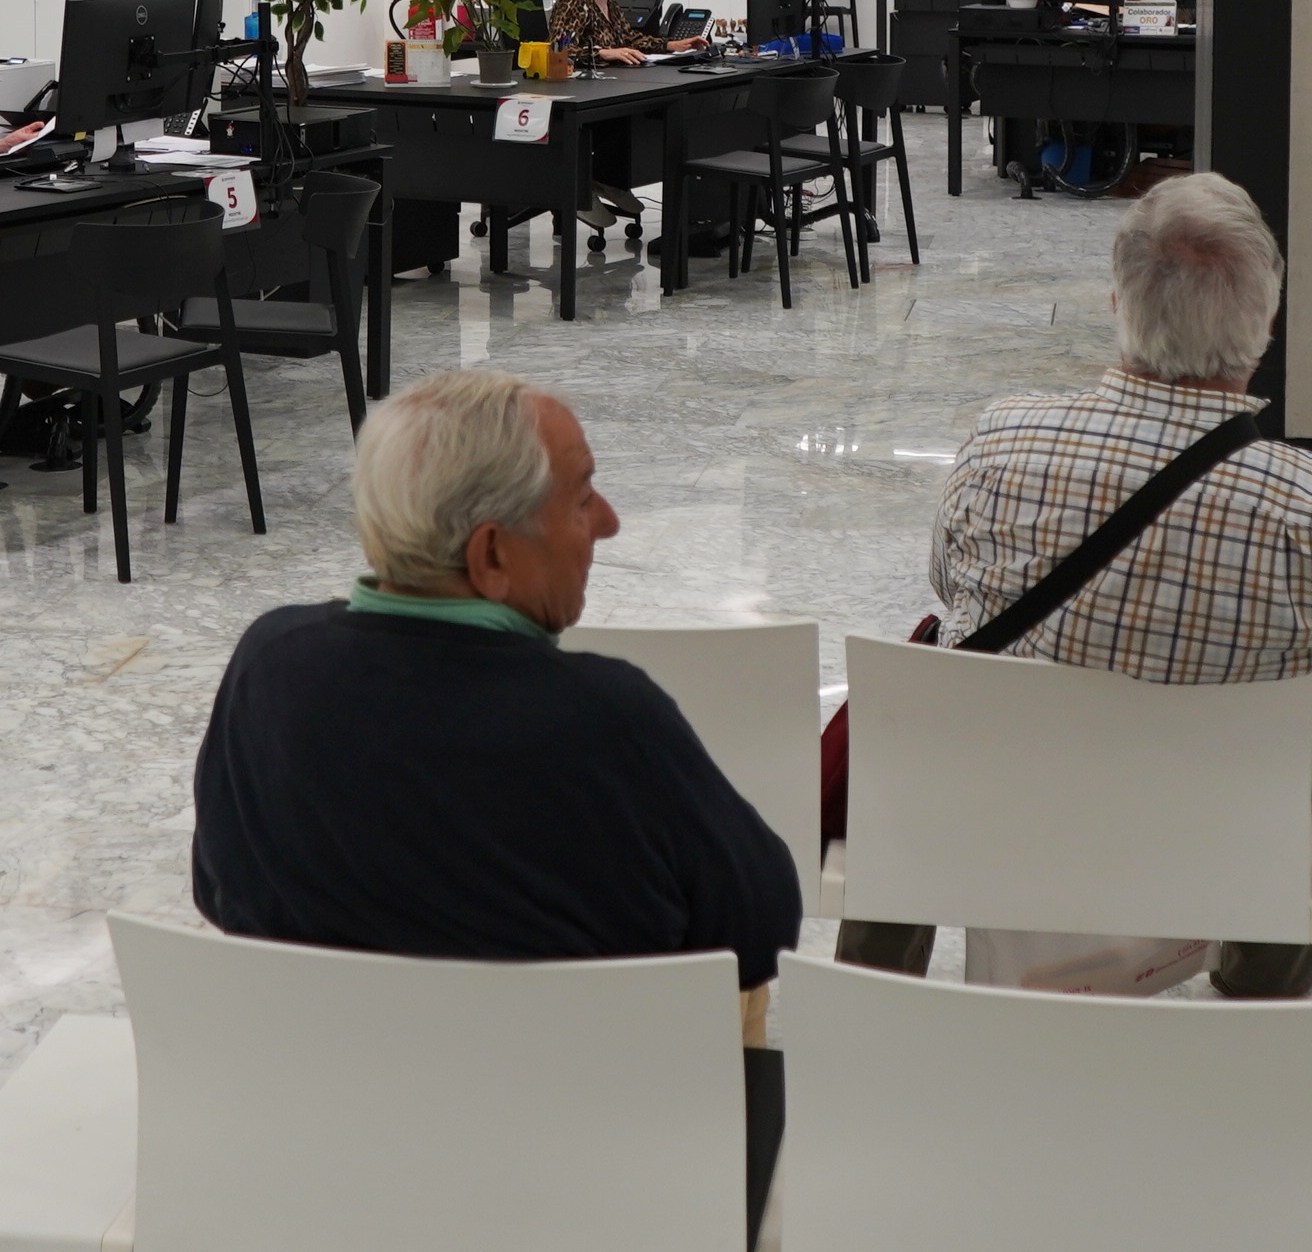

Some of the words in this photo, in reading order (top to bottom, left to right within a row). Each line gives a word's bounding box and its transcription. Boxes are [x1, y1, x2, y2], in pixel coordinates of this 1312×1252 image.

[1128, 8, 1171, 16] Colaborador
[1139, 16, 1159, 24] ORO
[518, 109, 530, 126] 6
[227, 186, 237, 208] 5
